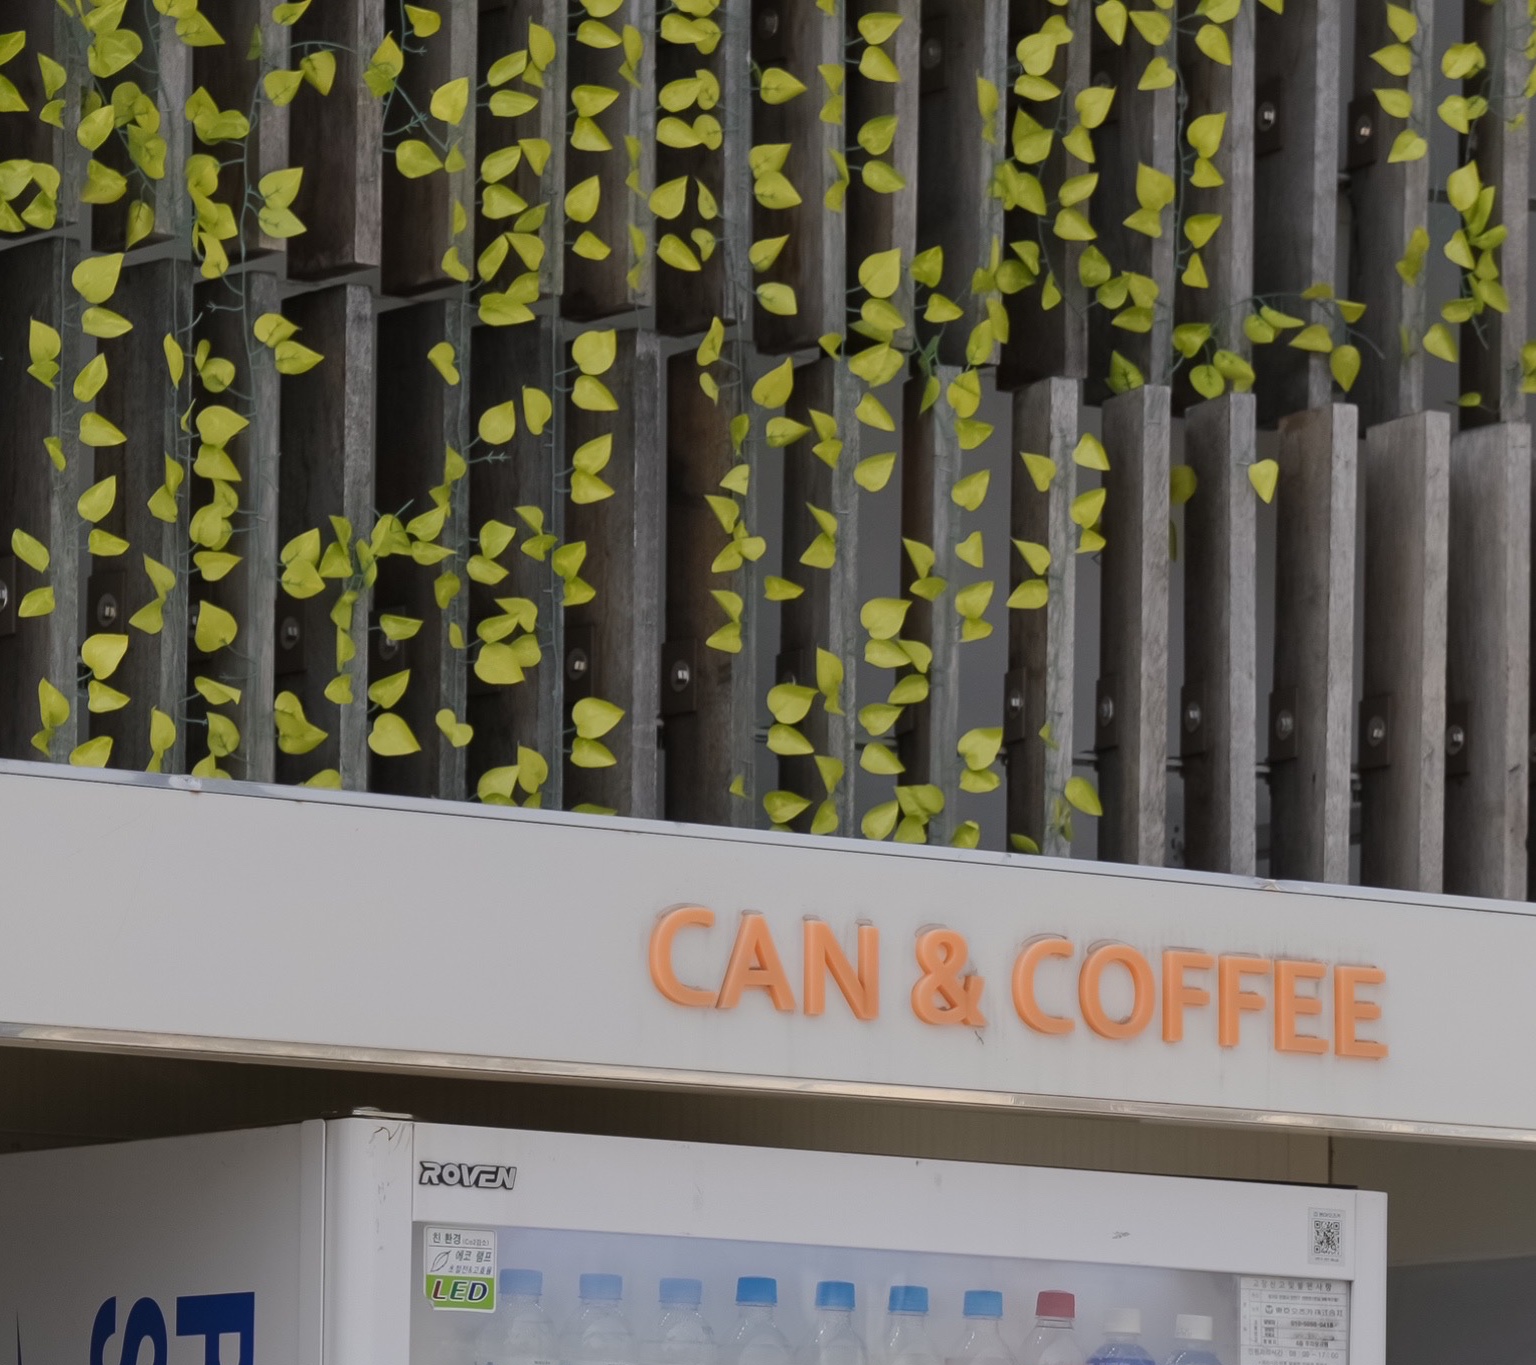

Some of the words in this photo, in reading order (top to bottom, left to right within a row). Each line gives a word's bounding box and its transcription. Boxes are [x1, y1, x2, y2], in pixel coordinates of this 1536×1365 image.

[649, 906, 880, 1020] CAN
[911, 928, 988, 1028] &
[1011, 939, 1388, 1060] COFFEE
[419, 1161, 517, 1190] ROVEN
[456, 1250, 472, 1261] 에코
[431, 1278, 489, 1302] LED
